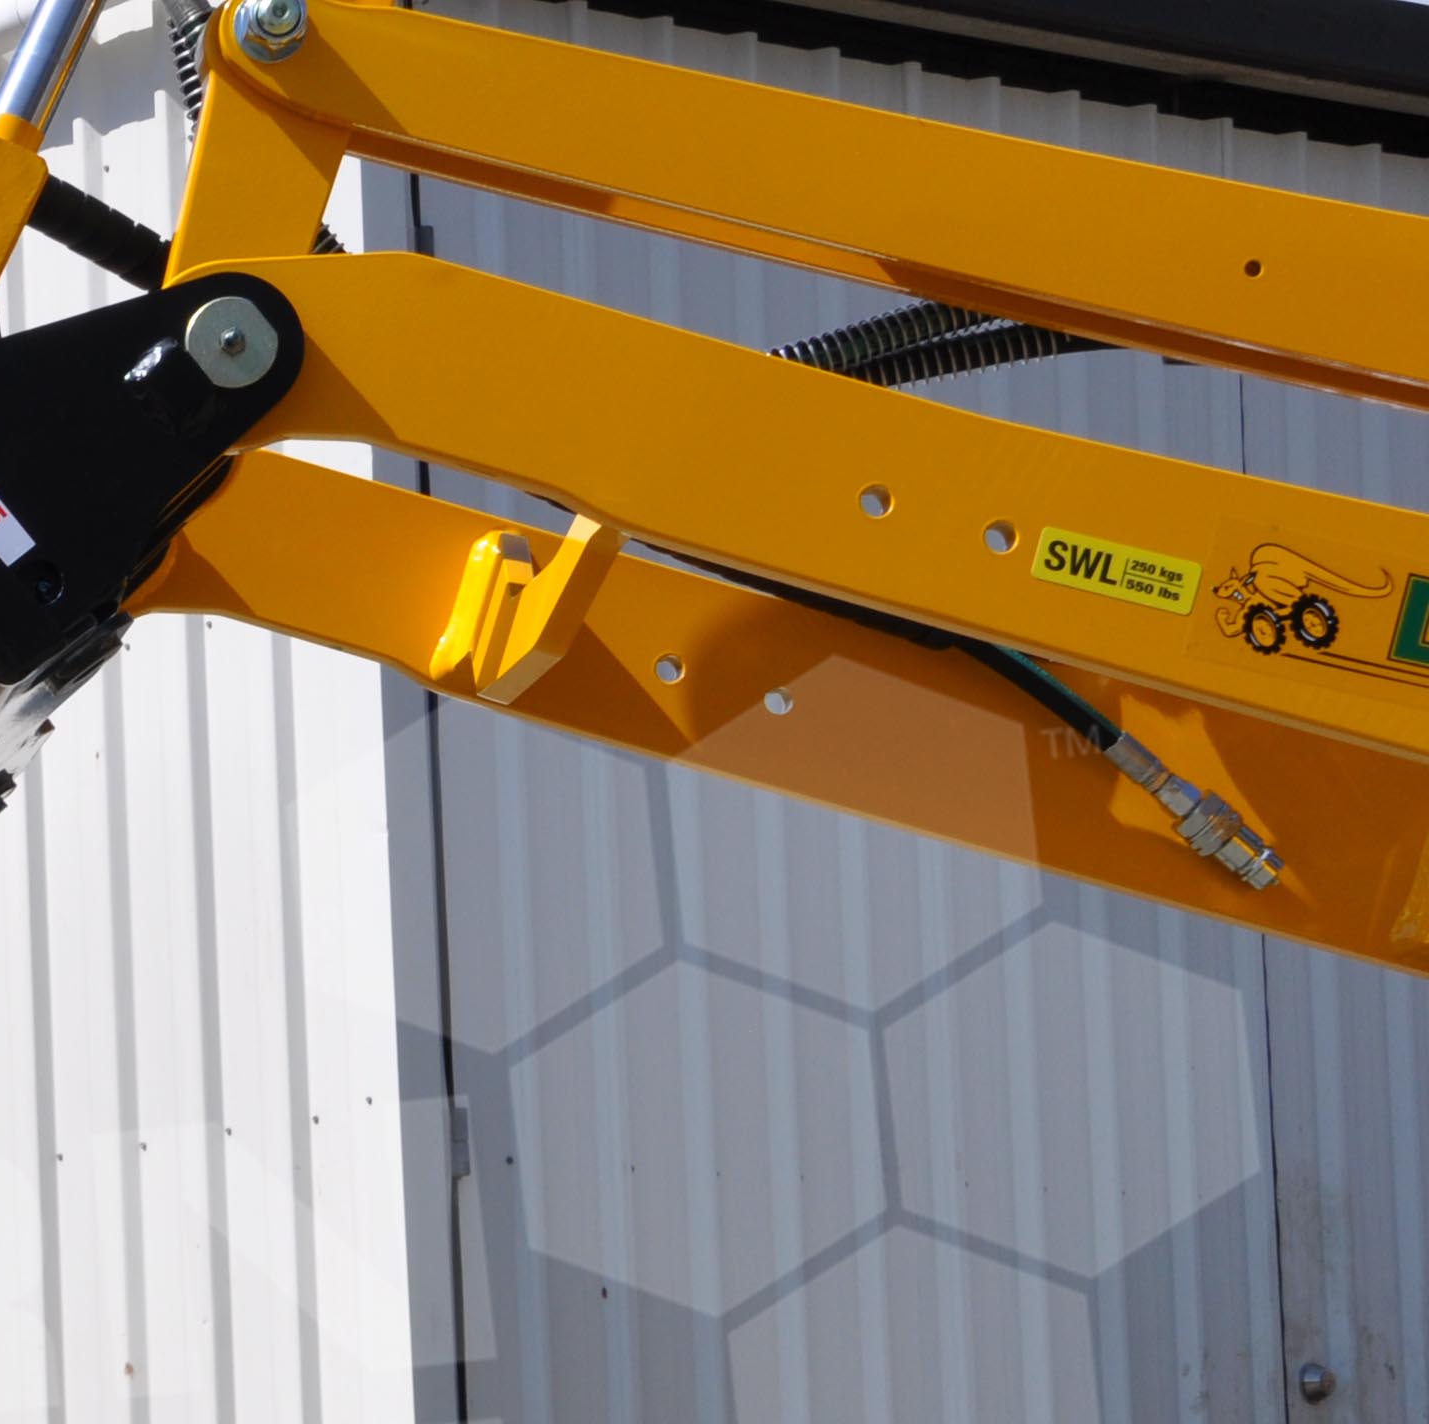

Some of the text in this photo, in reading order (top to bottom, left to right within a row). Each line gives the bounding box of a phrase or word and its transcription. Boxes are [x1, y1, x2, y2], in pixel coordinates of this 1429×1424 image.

[1044, 539, 1118, 586] SWL
[1130, 560, 1184, 583] 250 kgs
[1125, 578, 1181, 602] 550 lbs
